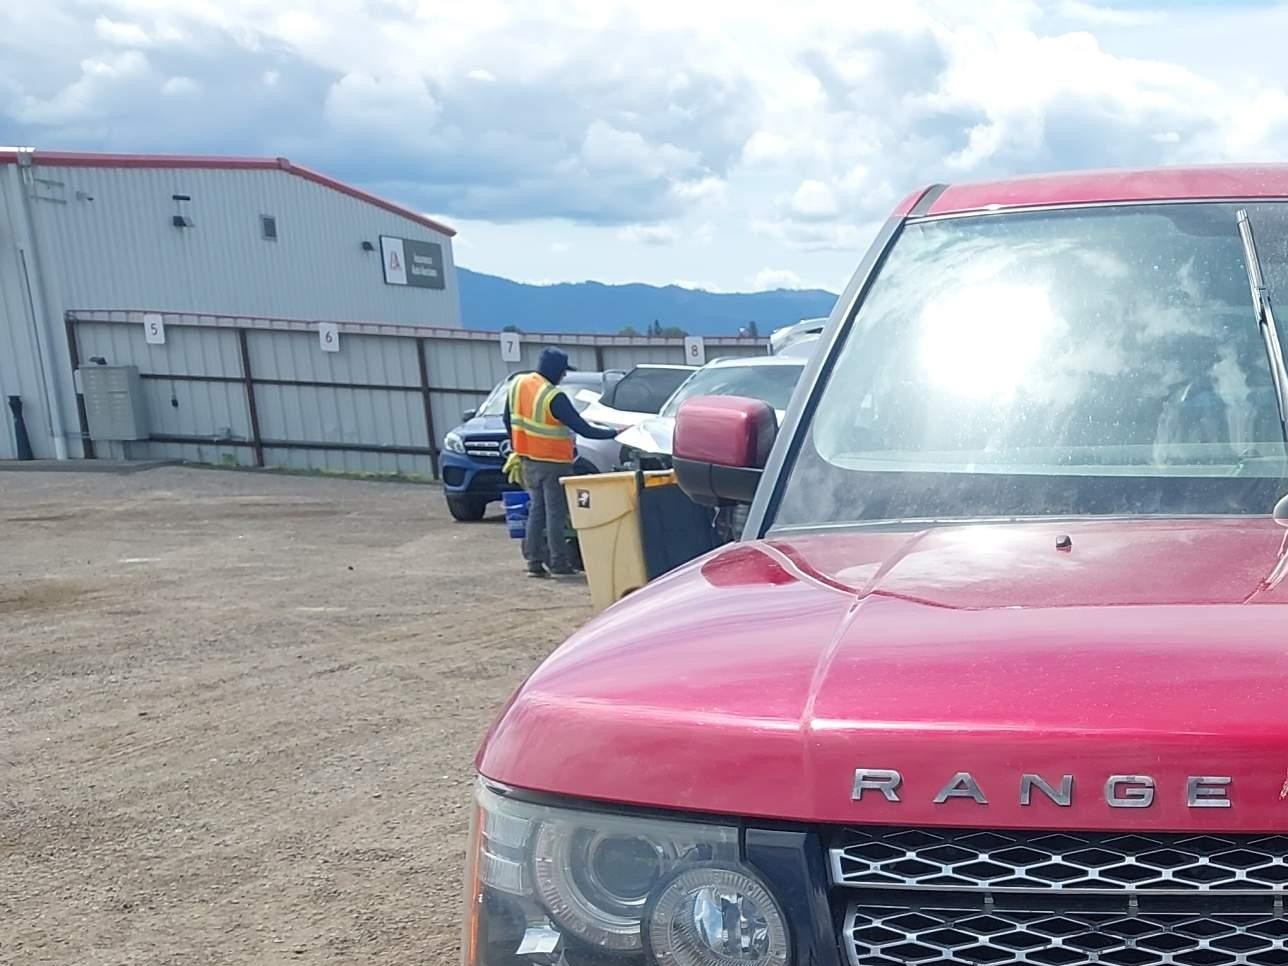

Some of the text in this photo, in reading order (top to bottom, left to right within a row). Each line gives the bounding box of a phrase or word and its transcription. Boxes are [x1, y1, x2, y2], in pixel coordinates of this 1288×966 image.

[150, 322, 158, 336] 5
[325, 331, 333, 344] 6
[506, 340, 513, 353] 7
[691, 344, 699, 357] 8
[851, 767, 1233, 808] RANGE
